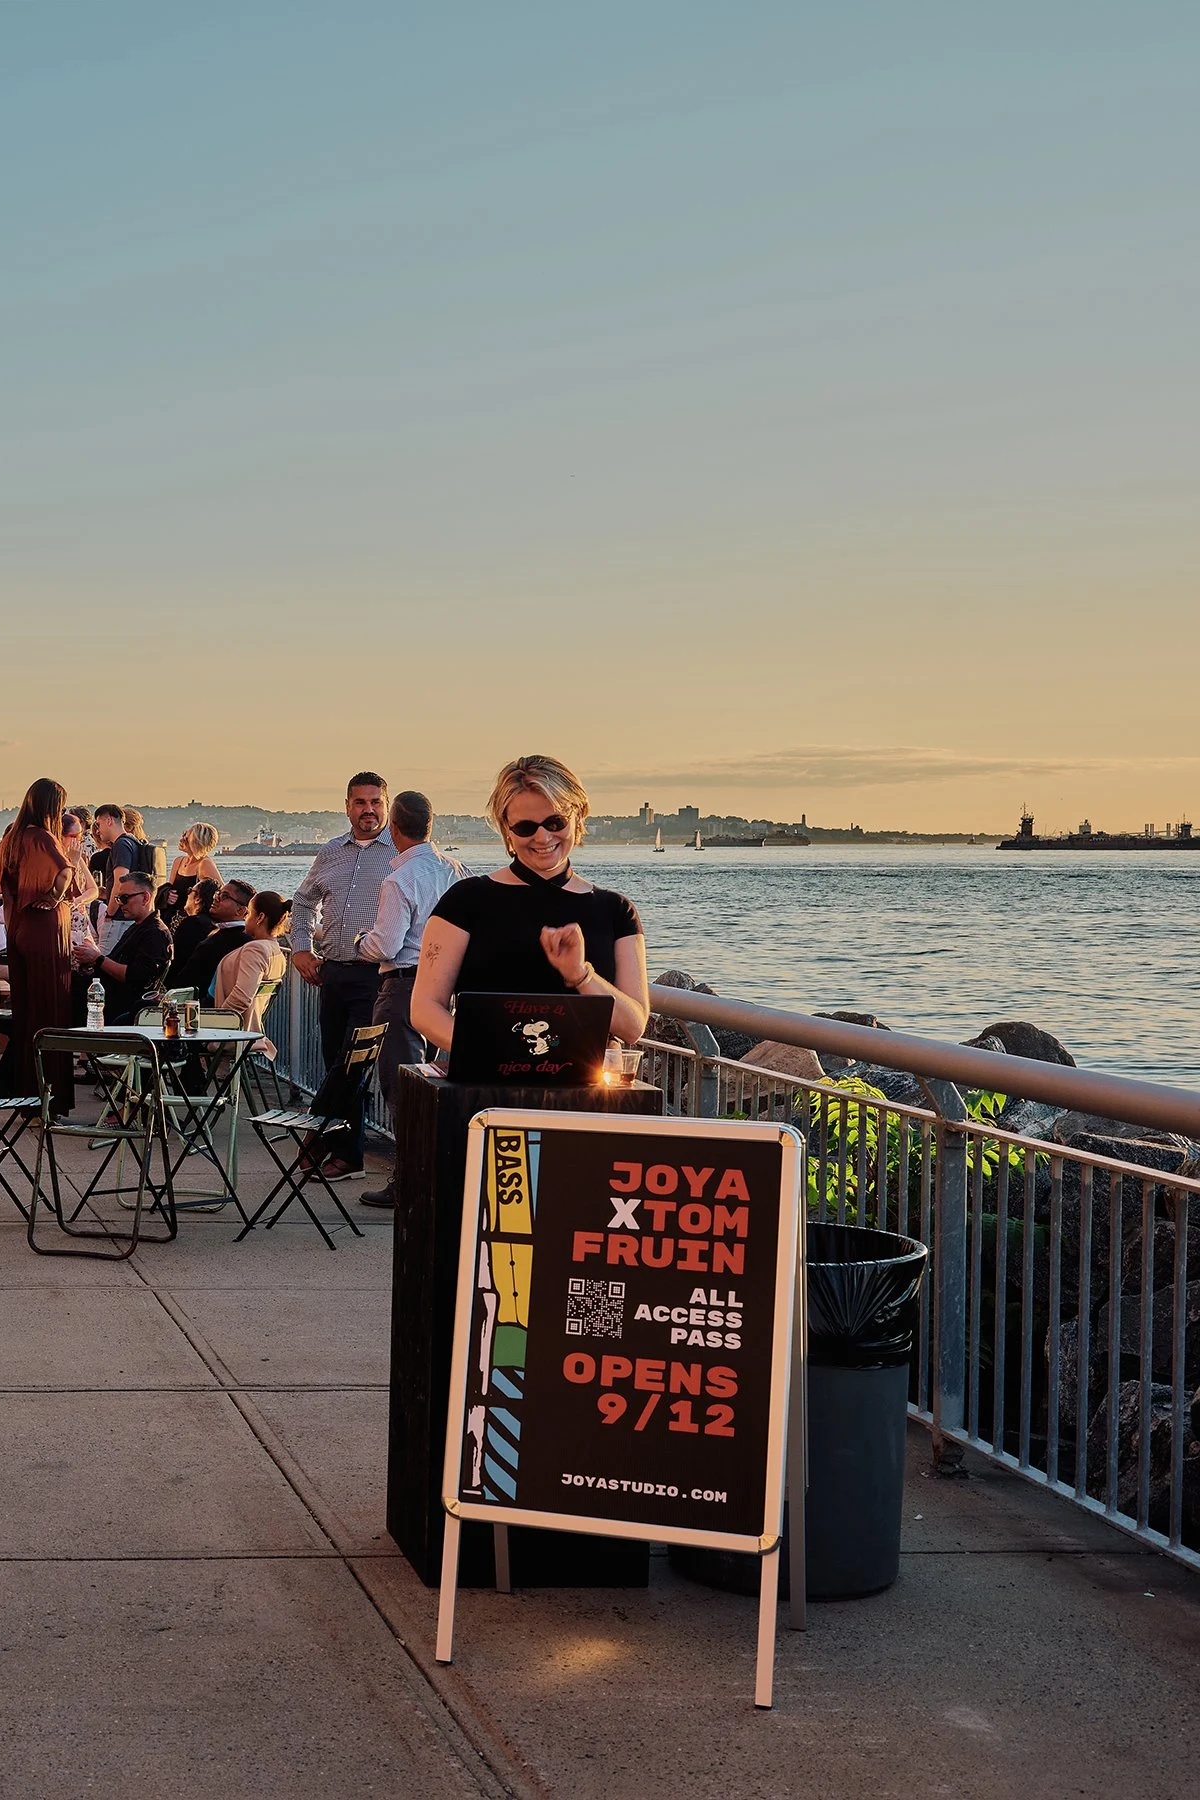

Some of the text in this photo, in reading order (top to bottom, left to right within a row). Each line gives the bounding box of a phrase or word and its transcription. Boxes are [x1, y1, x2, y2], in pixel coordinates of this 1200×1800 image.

[503, 1000, 566, 1017] Have a
[497, 1059, 573, 1076] nice day
[495, 1135, 523, 1206] BASS
[608, 1161, 751, 1201] JOYA
[572, 1230, 745, 1275] FRUIN
[688, 1287, 744, 1308] ALL
[633, 1303, 743, 1329] ACCESS
[670, 1327, 742, 1350] PASS
[562, 1352, 739, 1398] OPENS
[597, 1392, 735, 1437] 9/12
[561, 1473, 728, 1503] JOYASTUDIO.COM
